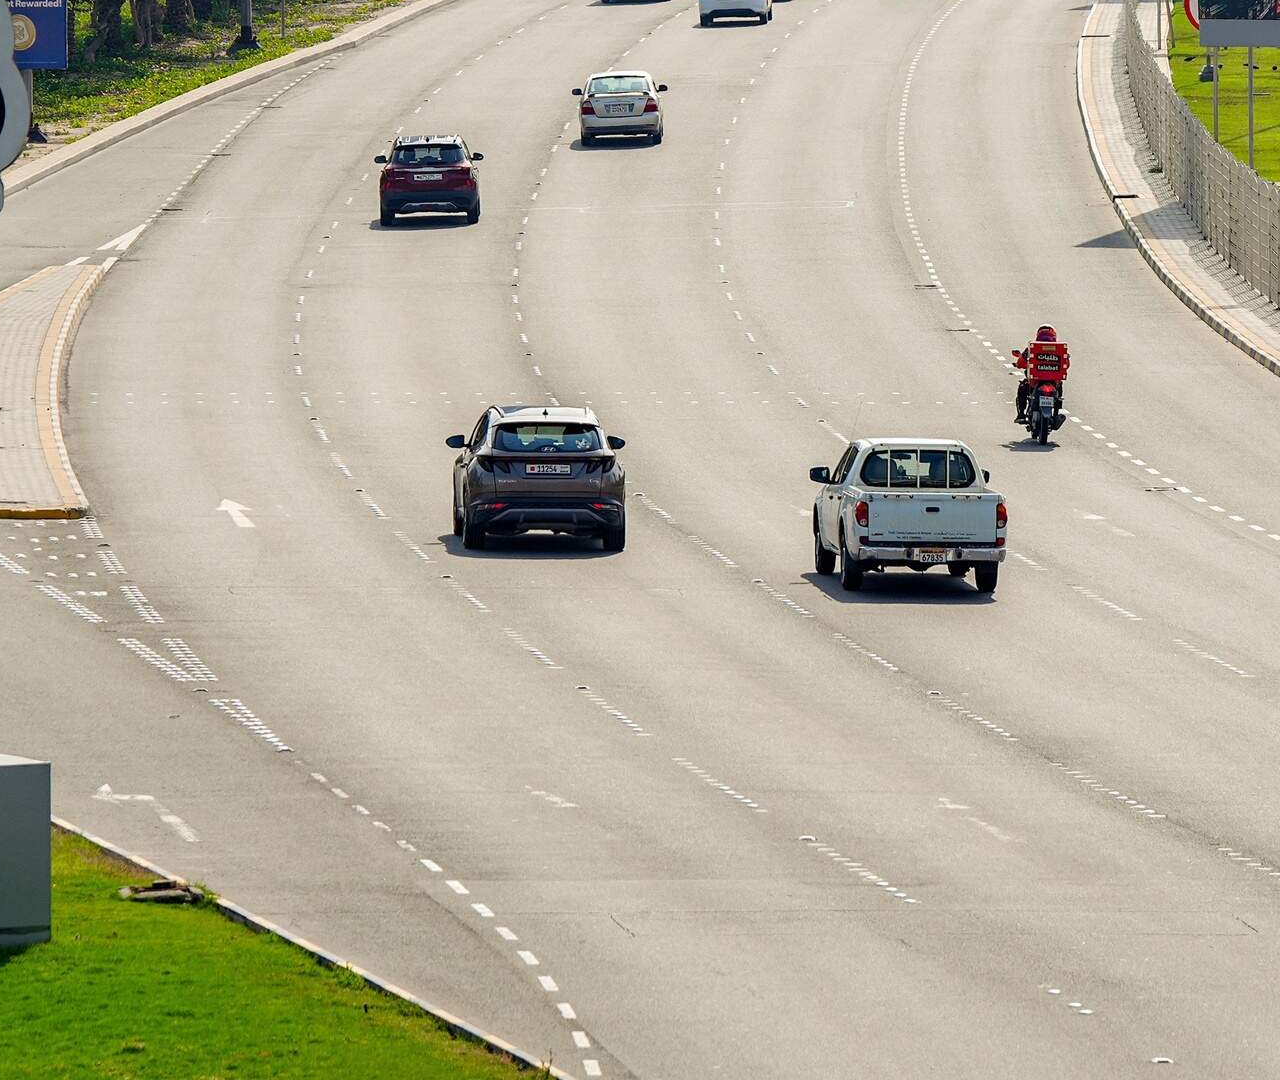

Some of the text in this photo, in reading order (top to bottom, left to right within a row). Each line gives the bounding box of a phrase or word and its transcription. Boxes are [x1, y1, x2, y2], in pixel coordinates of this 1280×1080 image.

[15, 0, 62, 8] Rewarded!
[1037, 354, 1059, 362] طلبات
[922, 553, 944, 562] 67835
